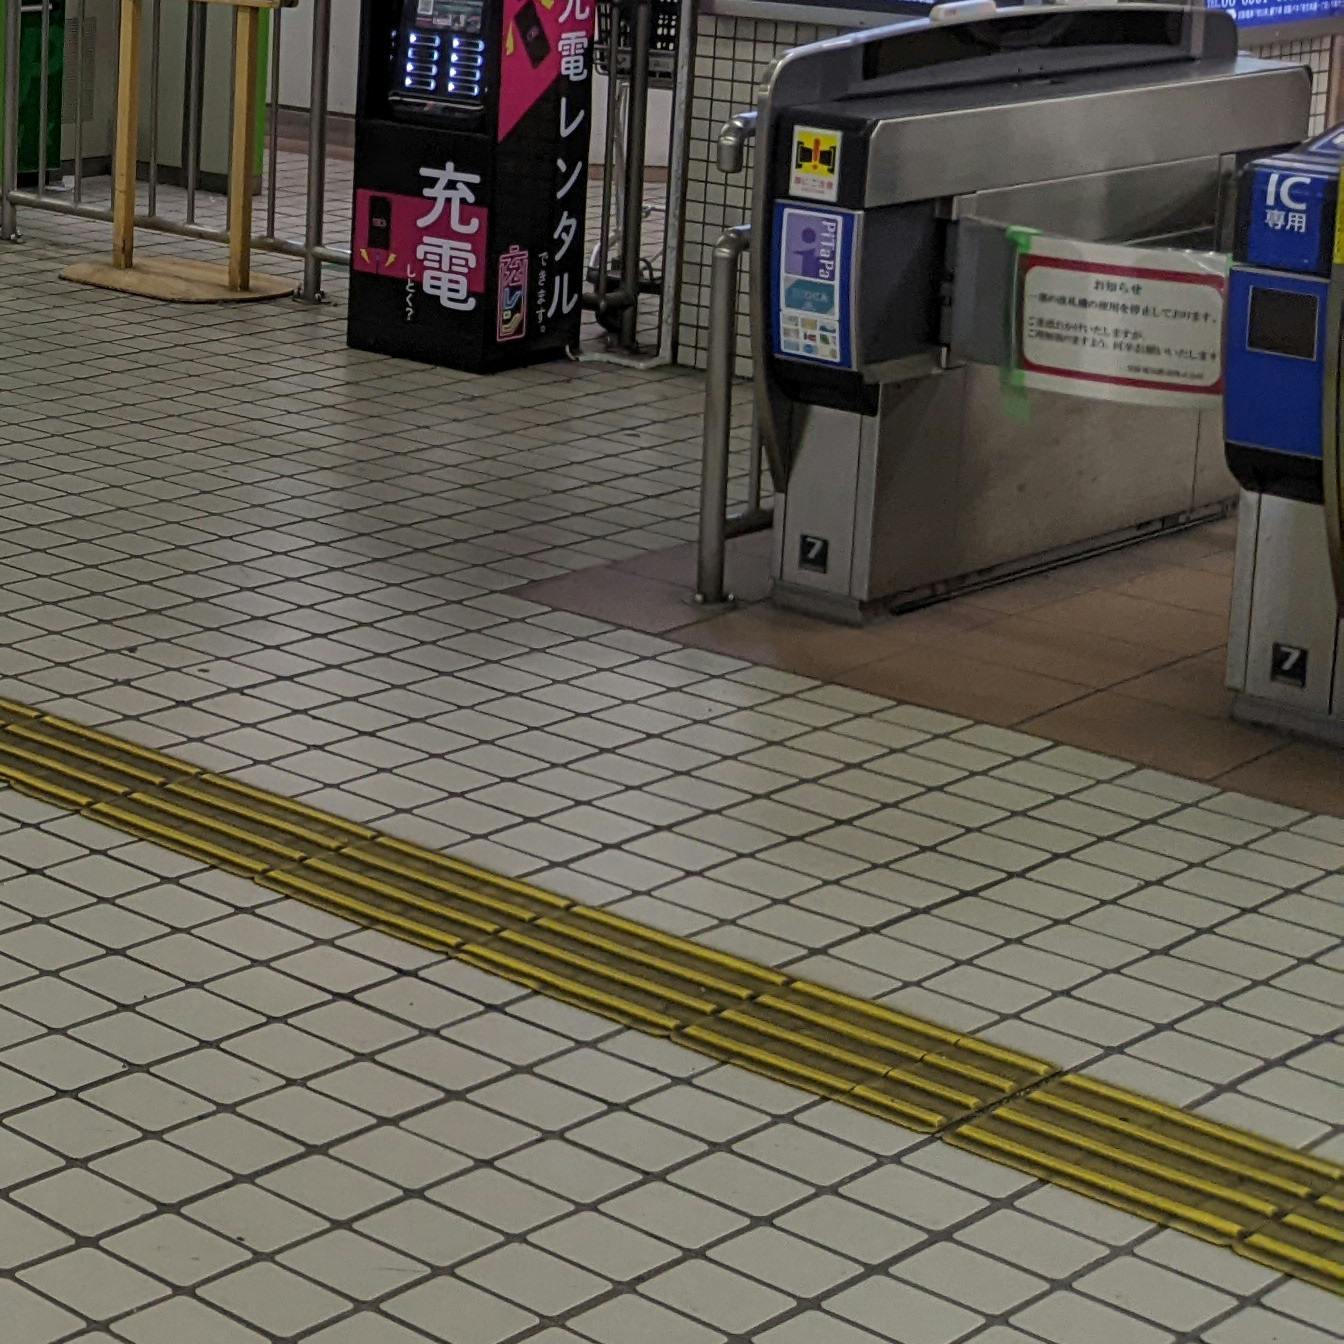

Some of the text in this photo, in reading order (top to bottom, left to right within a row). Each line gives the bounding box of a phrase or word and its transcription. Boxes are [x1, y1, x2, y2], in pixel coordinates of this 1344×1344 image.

[1265, 172, 1312, 211] IC
[1264, 209, 1307, 234] 専用
[415, 160, 482, 312] 充電
[1093, 279, 1143, 296] お知らせ
[805, 536, 823, 560] 7
[1279, 645, 1301, 671] 7
